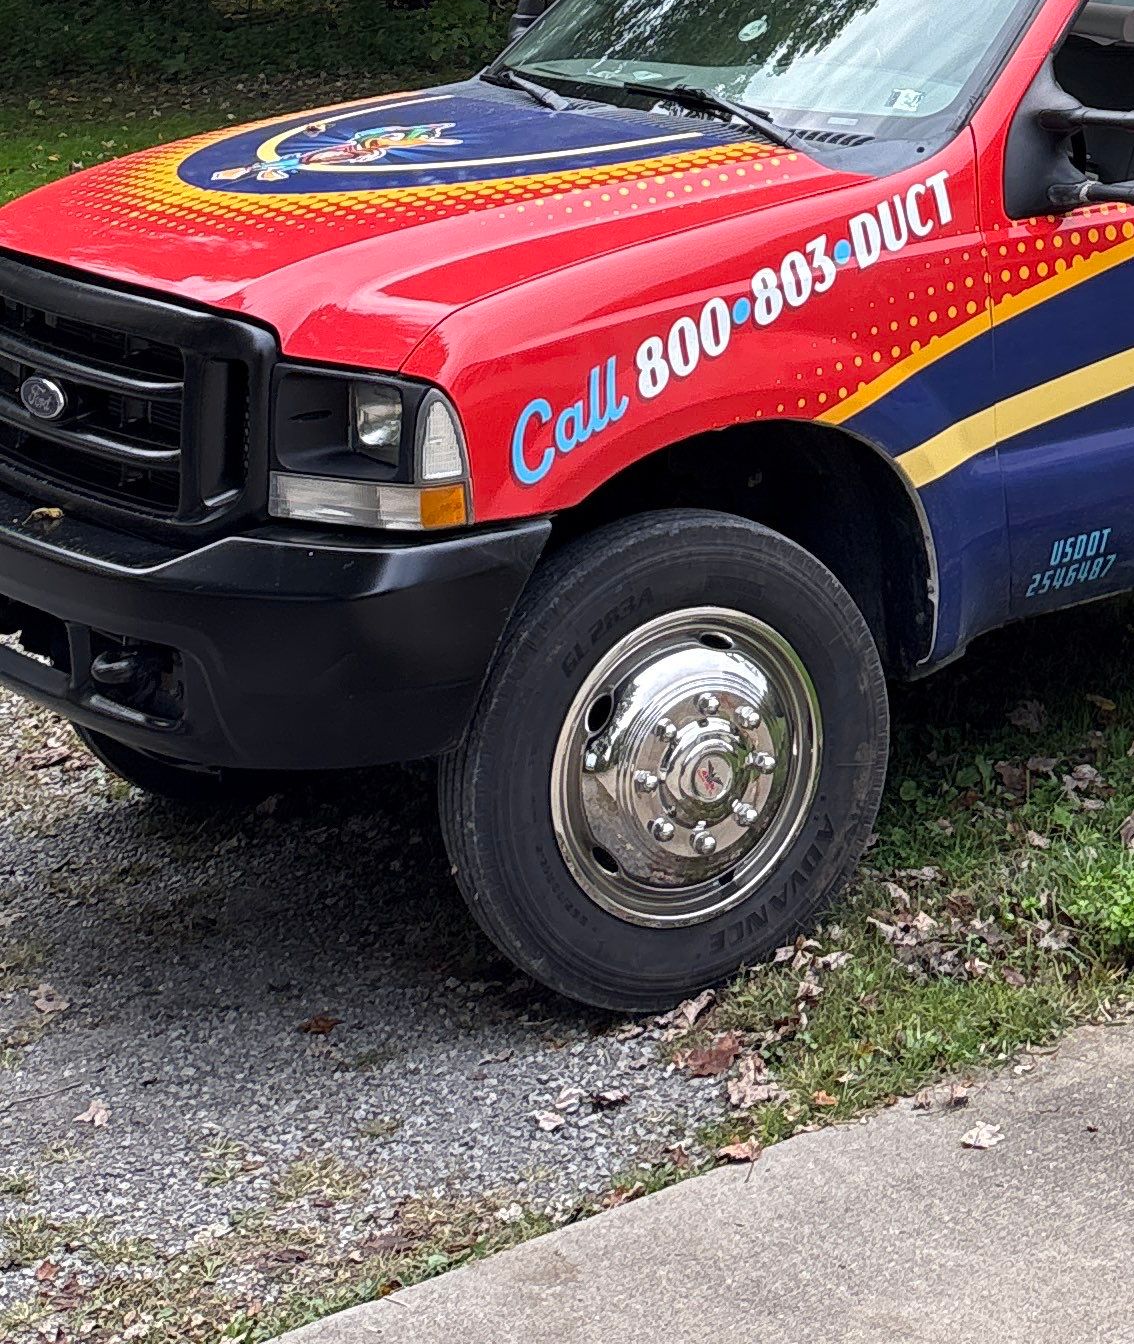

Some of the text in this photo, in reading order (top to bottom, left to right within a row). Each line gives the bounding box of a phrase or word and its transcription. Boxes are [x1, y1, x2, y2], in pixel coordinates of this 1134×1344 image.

[510, 355, 630, 486] Call
[1050, 527, 1112, 566] USDOT
[1025, 553, 1117, 598] 2546487
